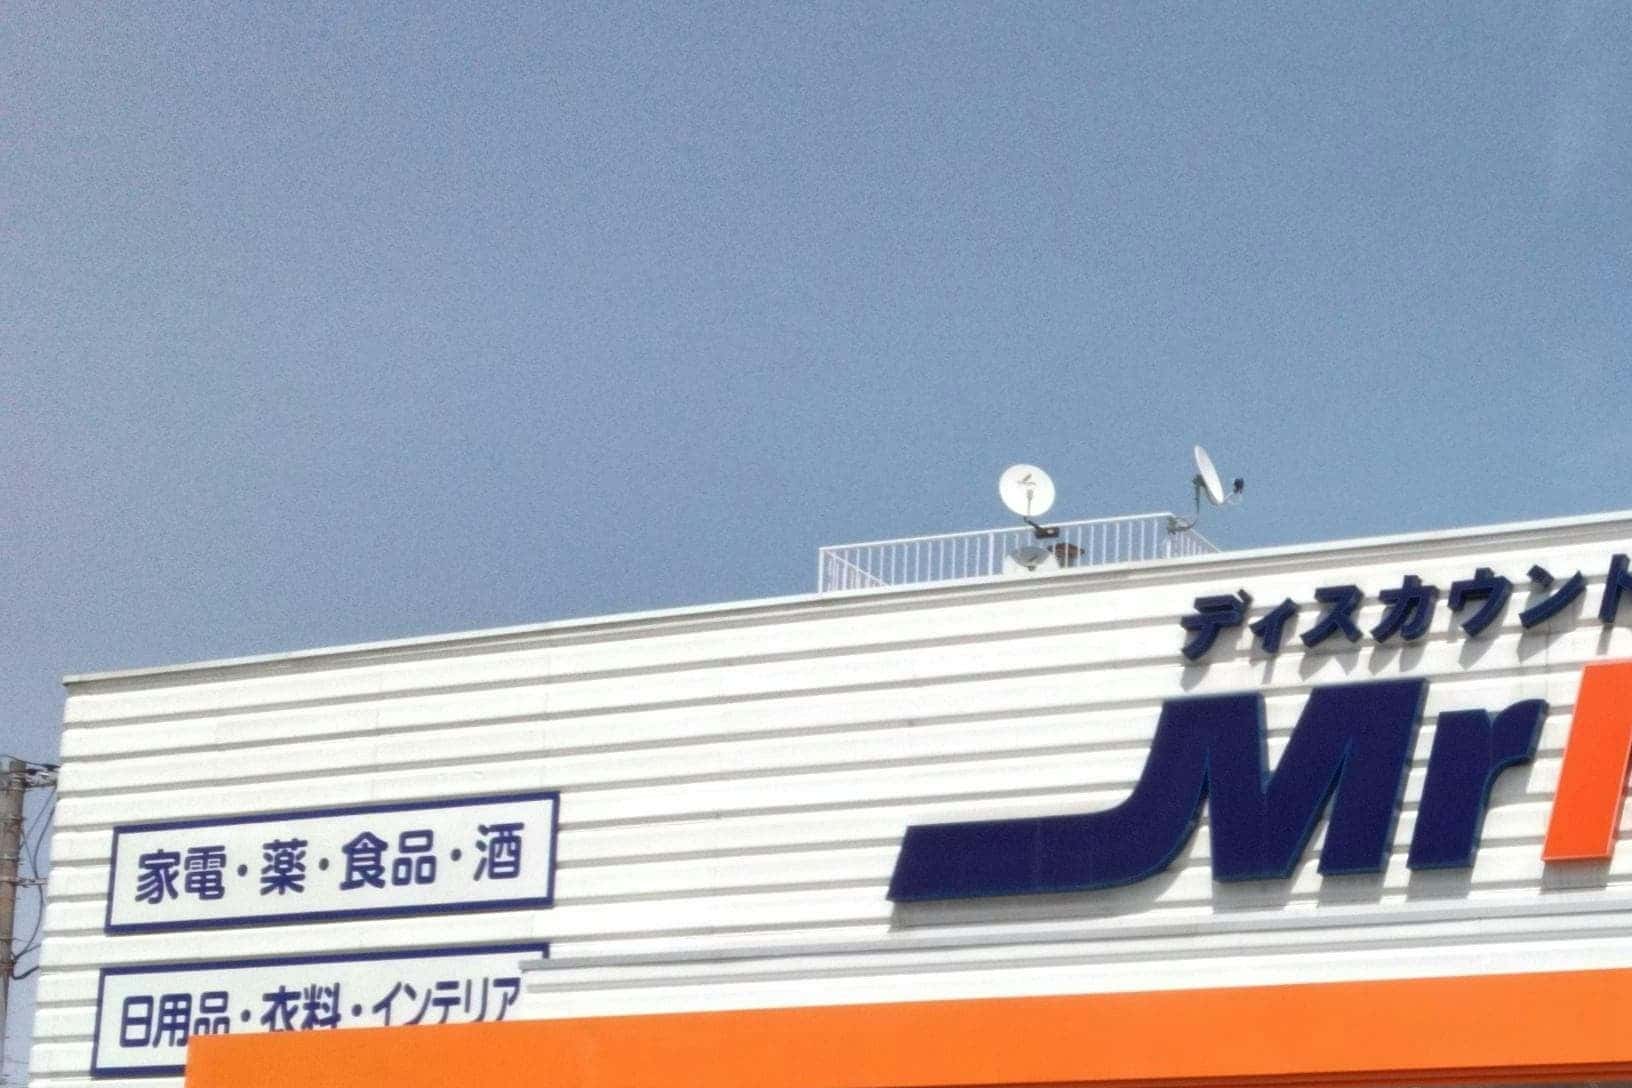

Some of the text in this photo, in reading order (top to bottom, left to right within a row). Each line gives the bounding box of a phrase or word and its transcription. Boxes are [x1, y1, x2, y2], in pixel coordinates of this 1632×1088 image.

[135, 822, 525, 905] 家電・薬・食品・酒
[119, 976, 522, 1049] 日用品・衣料・インテリア
